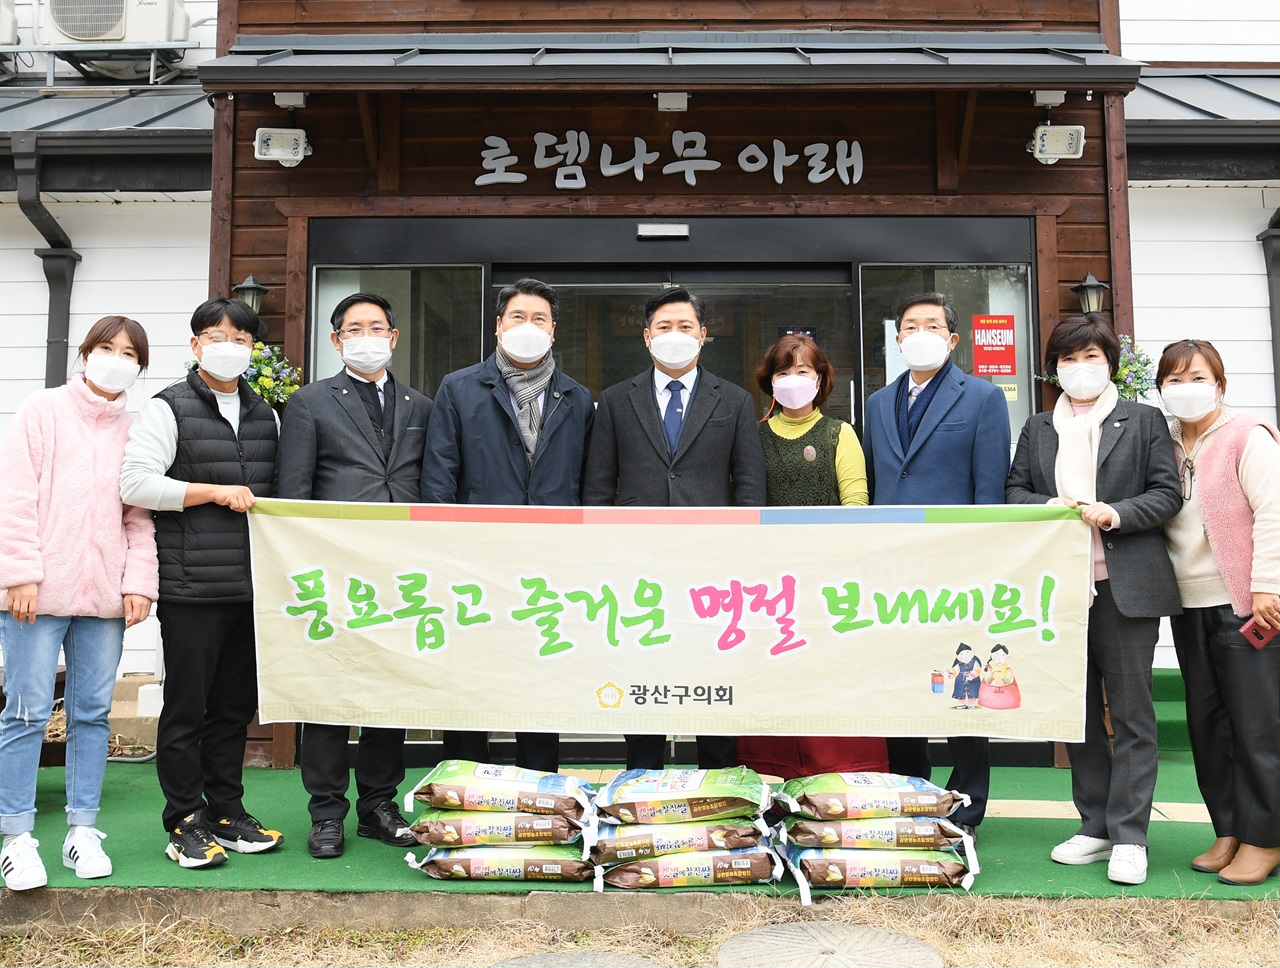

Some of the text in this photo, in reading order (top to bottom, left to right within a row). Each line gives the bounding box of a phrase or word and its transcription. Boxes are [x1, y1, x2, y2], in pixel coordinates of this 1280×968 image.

[475, 130, 863, 190] 로뎀나무 아래
[975, 329, 1013, 345] HANSEUM
[286, 569, 1055, 656] 풍요롭고 즐거운 명절 보내세요!
[629, 684, 734, 706] 광산구의회
